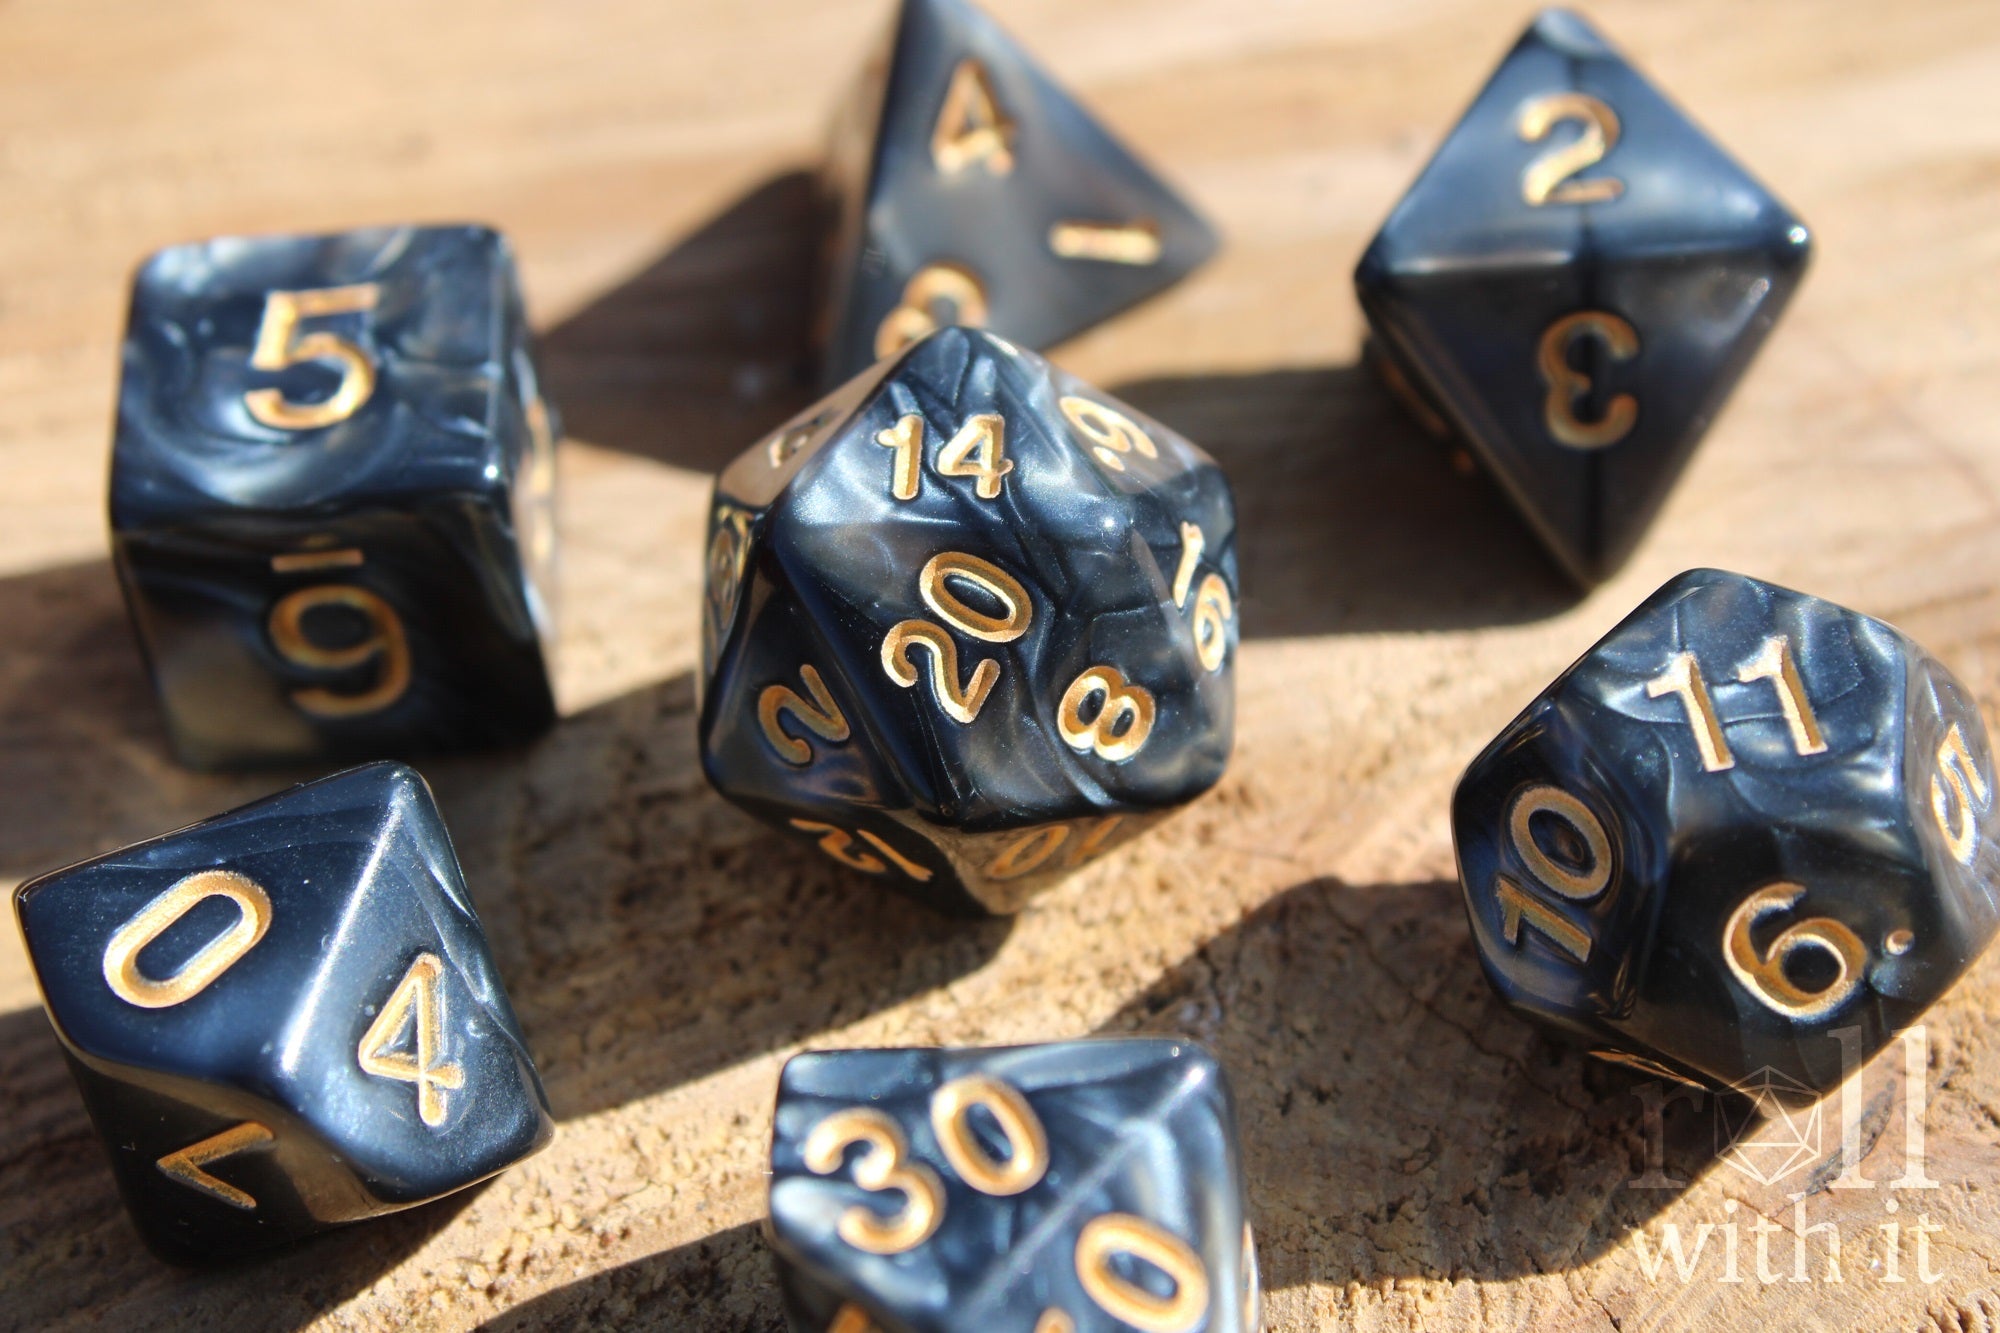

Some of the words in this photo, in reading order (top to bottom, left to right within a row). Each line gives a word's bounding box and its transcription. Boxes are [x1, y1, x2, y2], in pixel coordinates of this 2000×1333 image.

[930, 58, 1016, 178] 4
[1516, 92, 1624, 206] 2
[245, 282, 381, 430] 5
[1537, 310, 1640, 450] 3
[876, 413, 1014, 500] 14
[880, 550, 1034, 725] 20
[1646, 634, 1829, 773] 11
[757, 664, 852, 766] 2
[1056, 664, 1157, 763] 8
[1931, 720, 1990, 867] 5
[102, 869, 273, 1009] 0
[1495, 785, 1614, 966] 10
[358, 951, 466, 1128] 4
[803, 1072, 1051, 1255] 30
